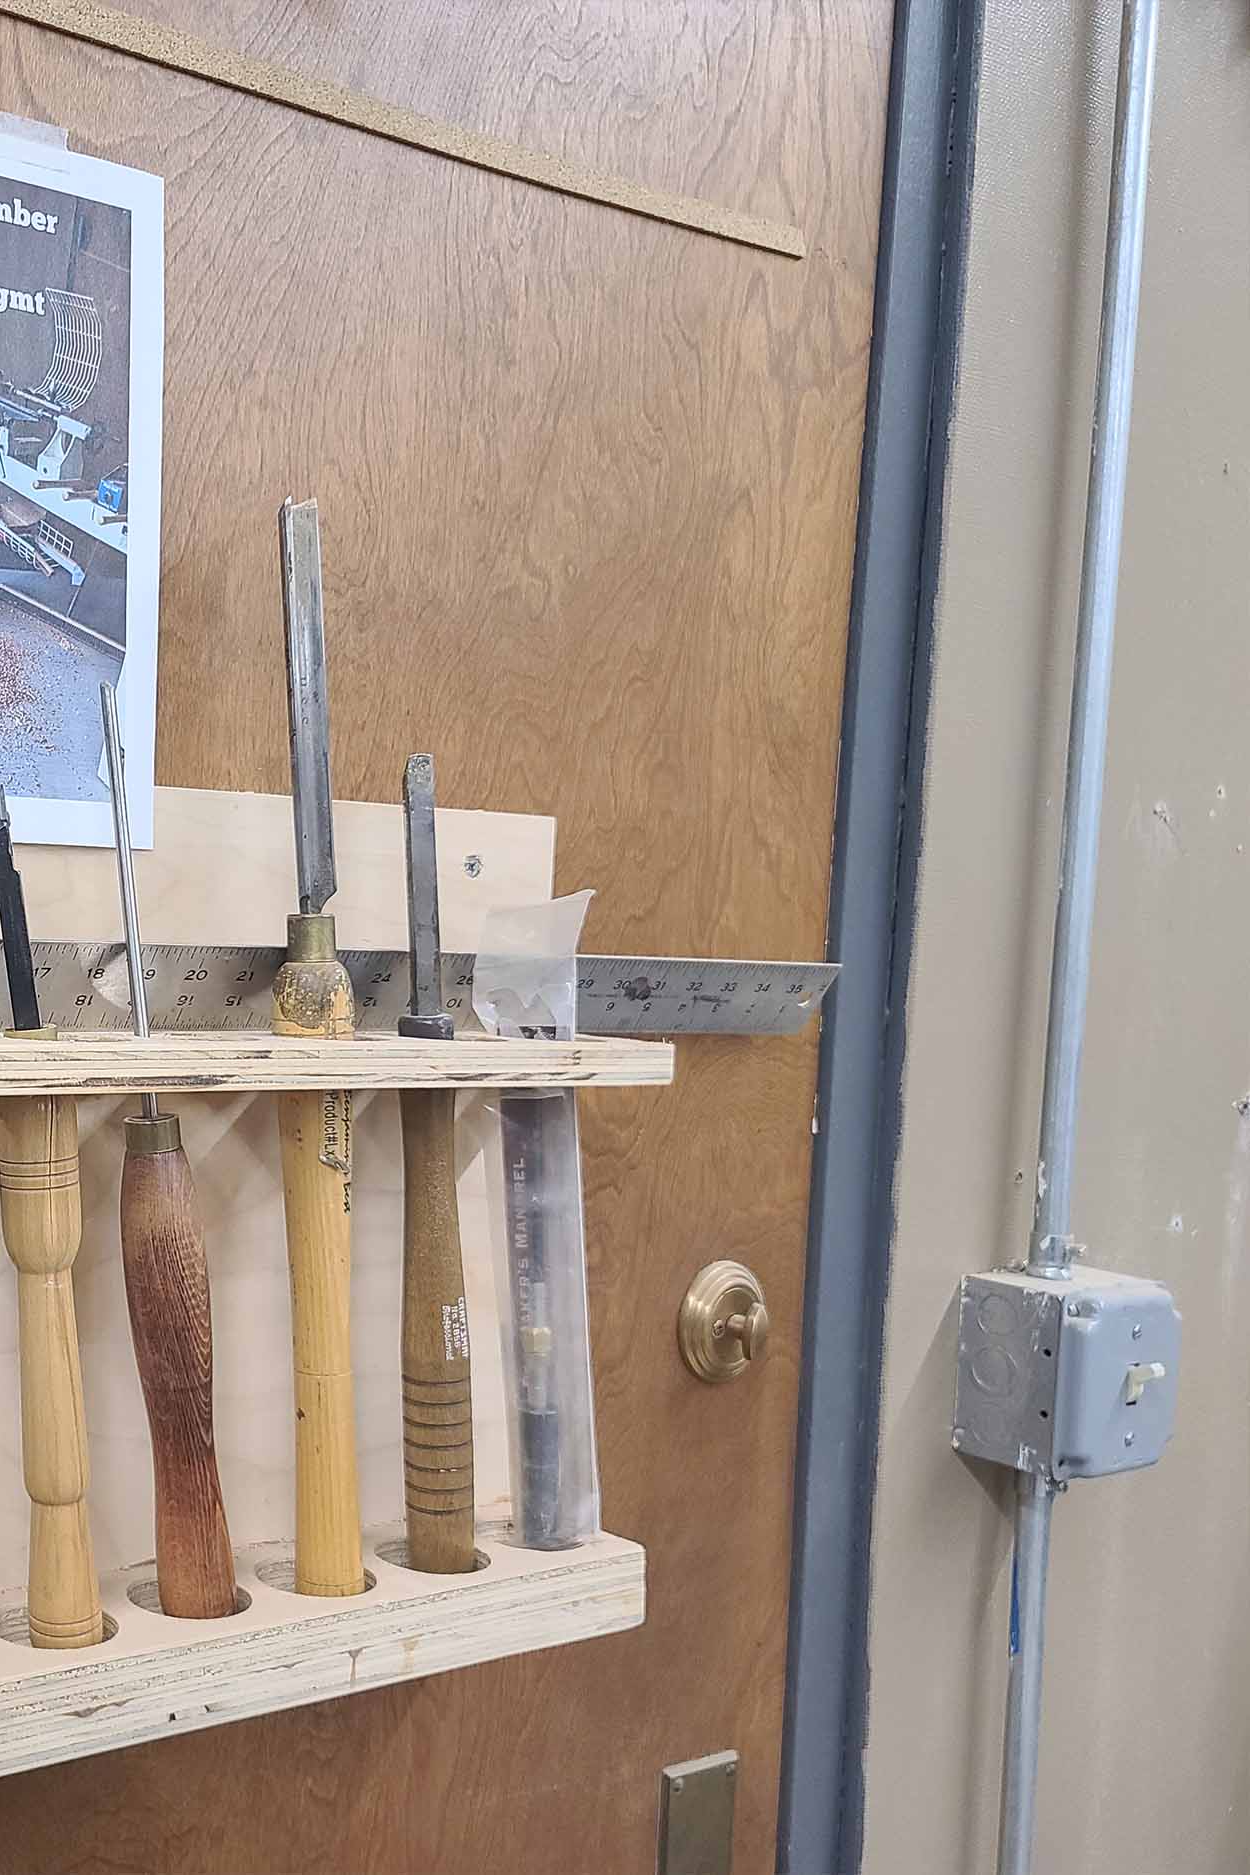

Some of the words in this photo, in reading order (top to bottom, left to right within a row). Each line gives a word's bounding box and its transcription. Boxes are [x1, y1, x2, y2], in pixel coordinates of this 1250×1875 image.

[34, 967, 51, 979] 17
[87, 968, 105, 979] 18
[184, 969, 208, 981] 20
[235, 971, 254, 982] 21
[371, 973, 391, 984] 24
[577, 979, 594, 989] 29
[652, 980, 666, 990] 31
[686, 982, 703, 992] 32
[720, 982, 737, 992] 33
[754, 983, 770, 993] 34
[513, 1157, 528, 1249] MANREL
